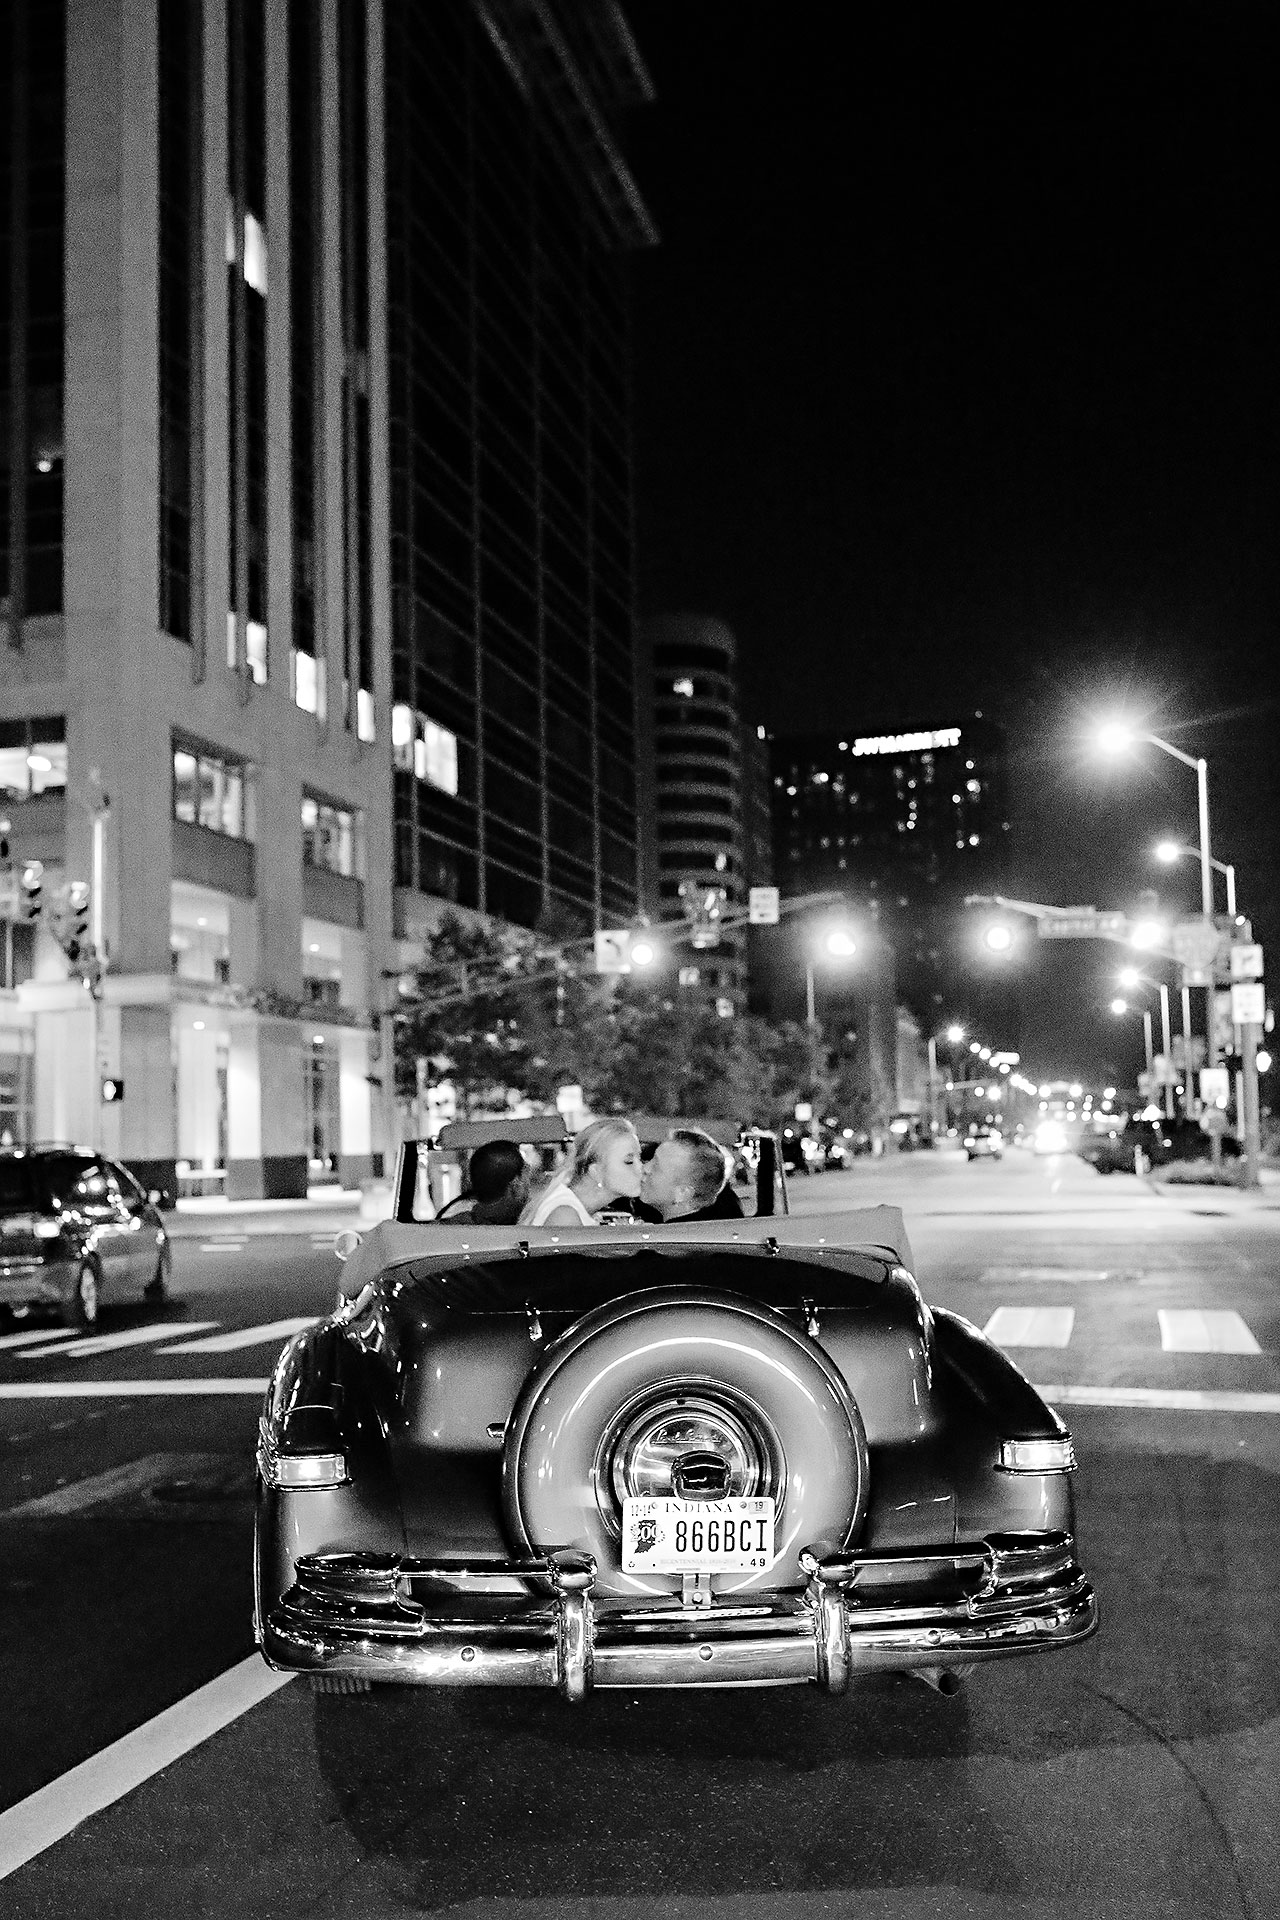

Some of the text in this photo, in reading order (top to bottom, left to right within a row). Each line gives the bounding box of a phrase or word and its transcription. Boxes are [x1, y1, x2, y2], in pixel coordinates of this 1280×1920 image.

[665, 1502, 733, 1513] INDIANA
[754, 1501, 764, 1510] 19
[676, 1520, 768, 1552] 866BCI
[750, 1558, 766, 1567] 49
